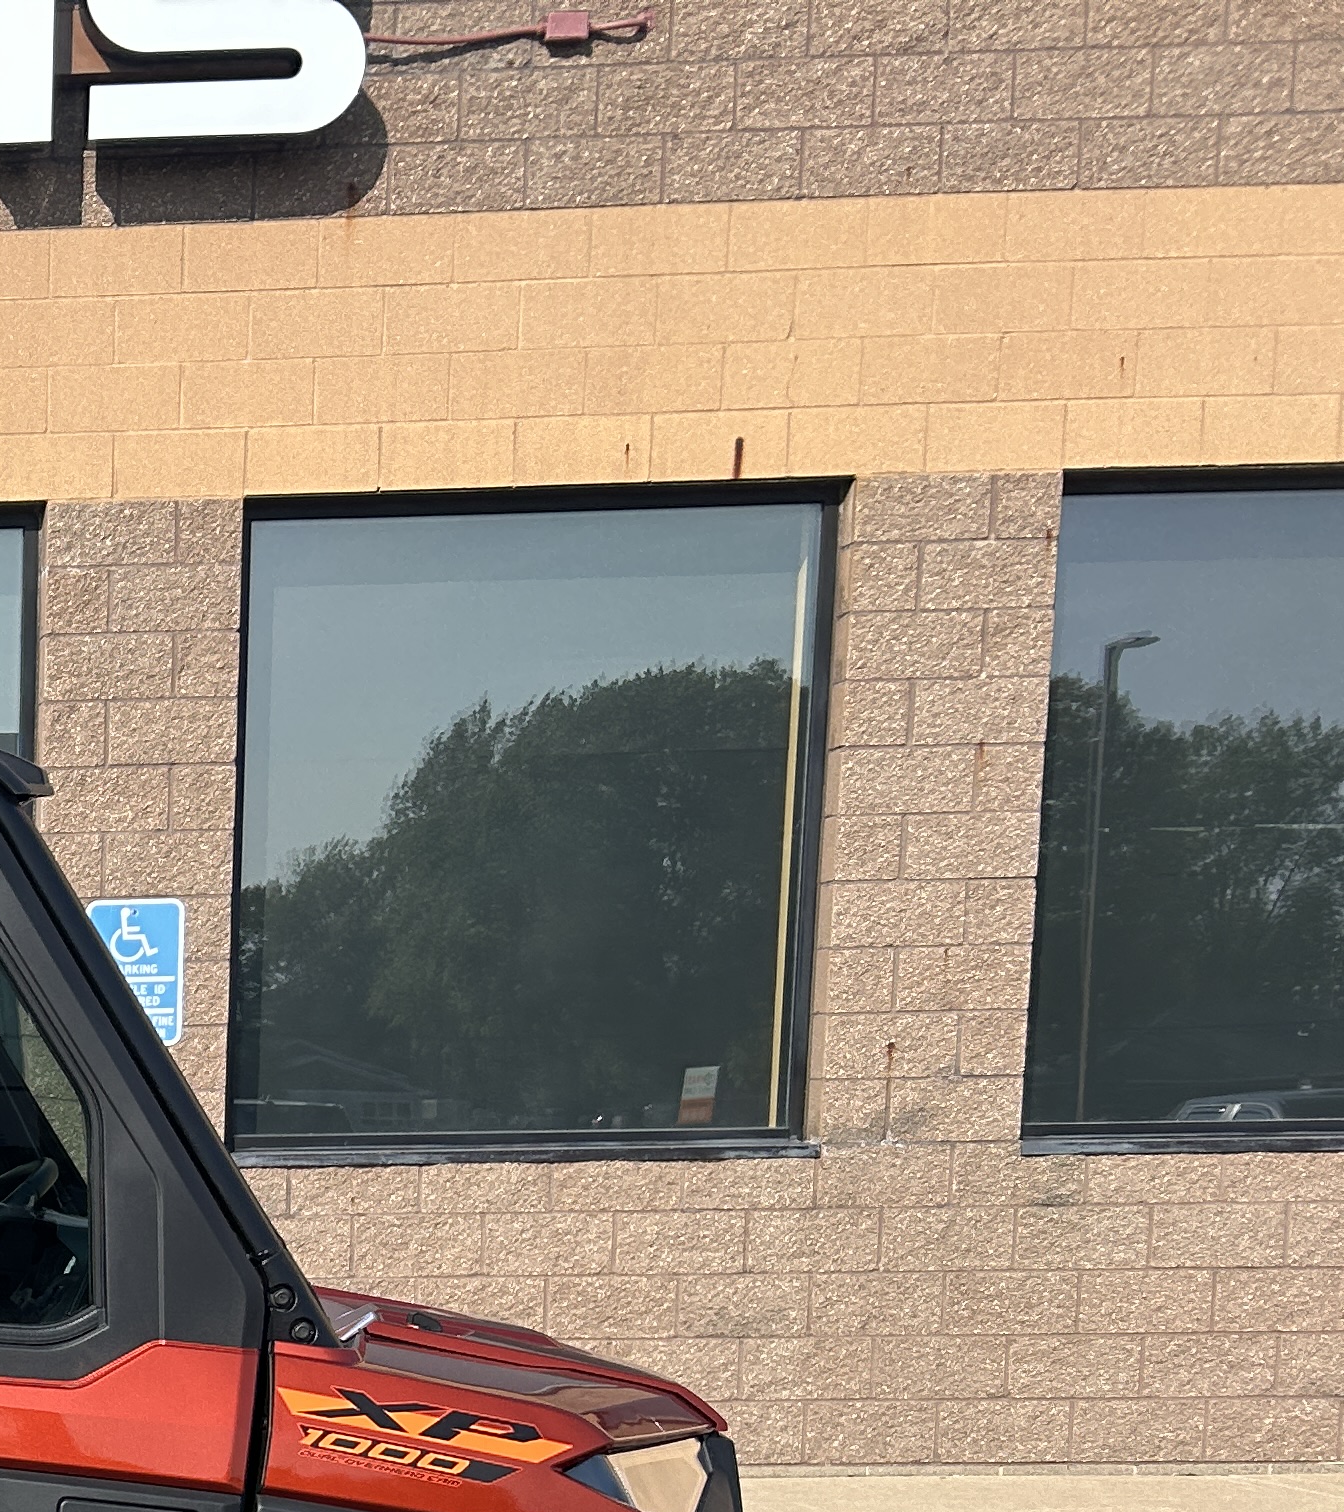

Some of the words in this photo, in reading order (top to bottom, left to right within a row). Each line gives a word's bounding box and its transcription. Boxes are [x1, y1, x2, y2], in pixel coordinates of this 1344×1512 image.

[120, 963, 158, 975] ARKING
[154, 984, 166, 995] ID
[296, 1385, 544, 1442] XP
[298, 1427, 471, 1475] 1000
[299, 1450, 339, 1464] DUAL
